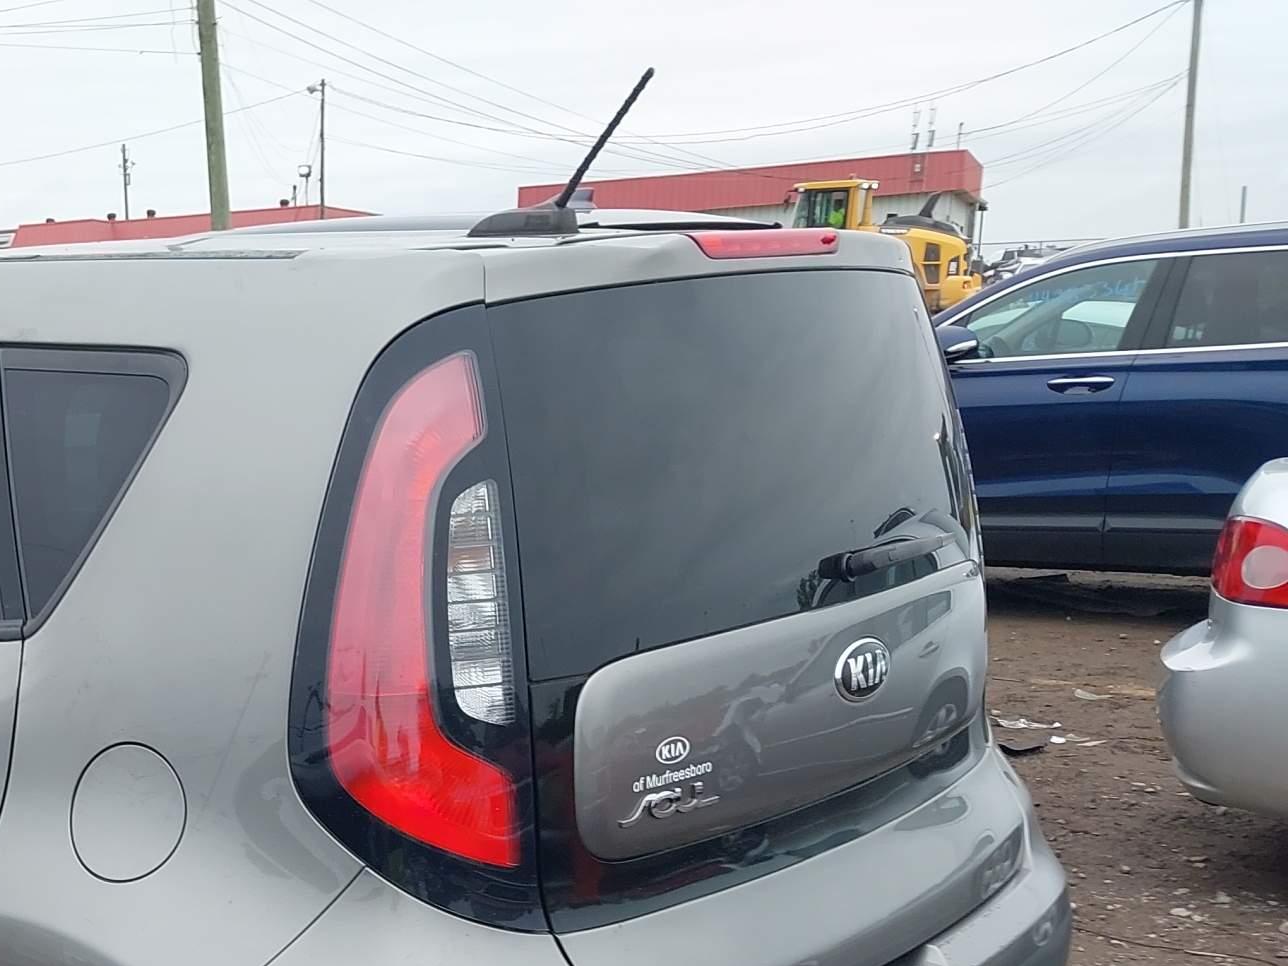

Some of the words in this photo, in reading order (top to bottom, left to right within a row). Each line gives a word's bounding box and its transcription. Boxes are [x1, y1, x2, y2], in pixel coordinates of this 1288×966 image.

[846, 649, 886, 691] KIA
[661, 741, 685, 760] KIA
[632, 776, 646, 793] of
[645, 761, 713, 790] Murfreesboro
